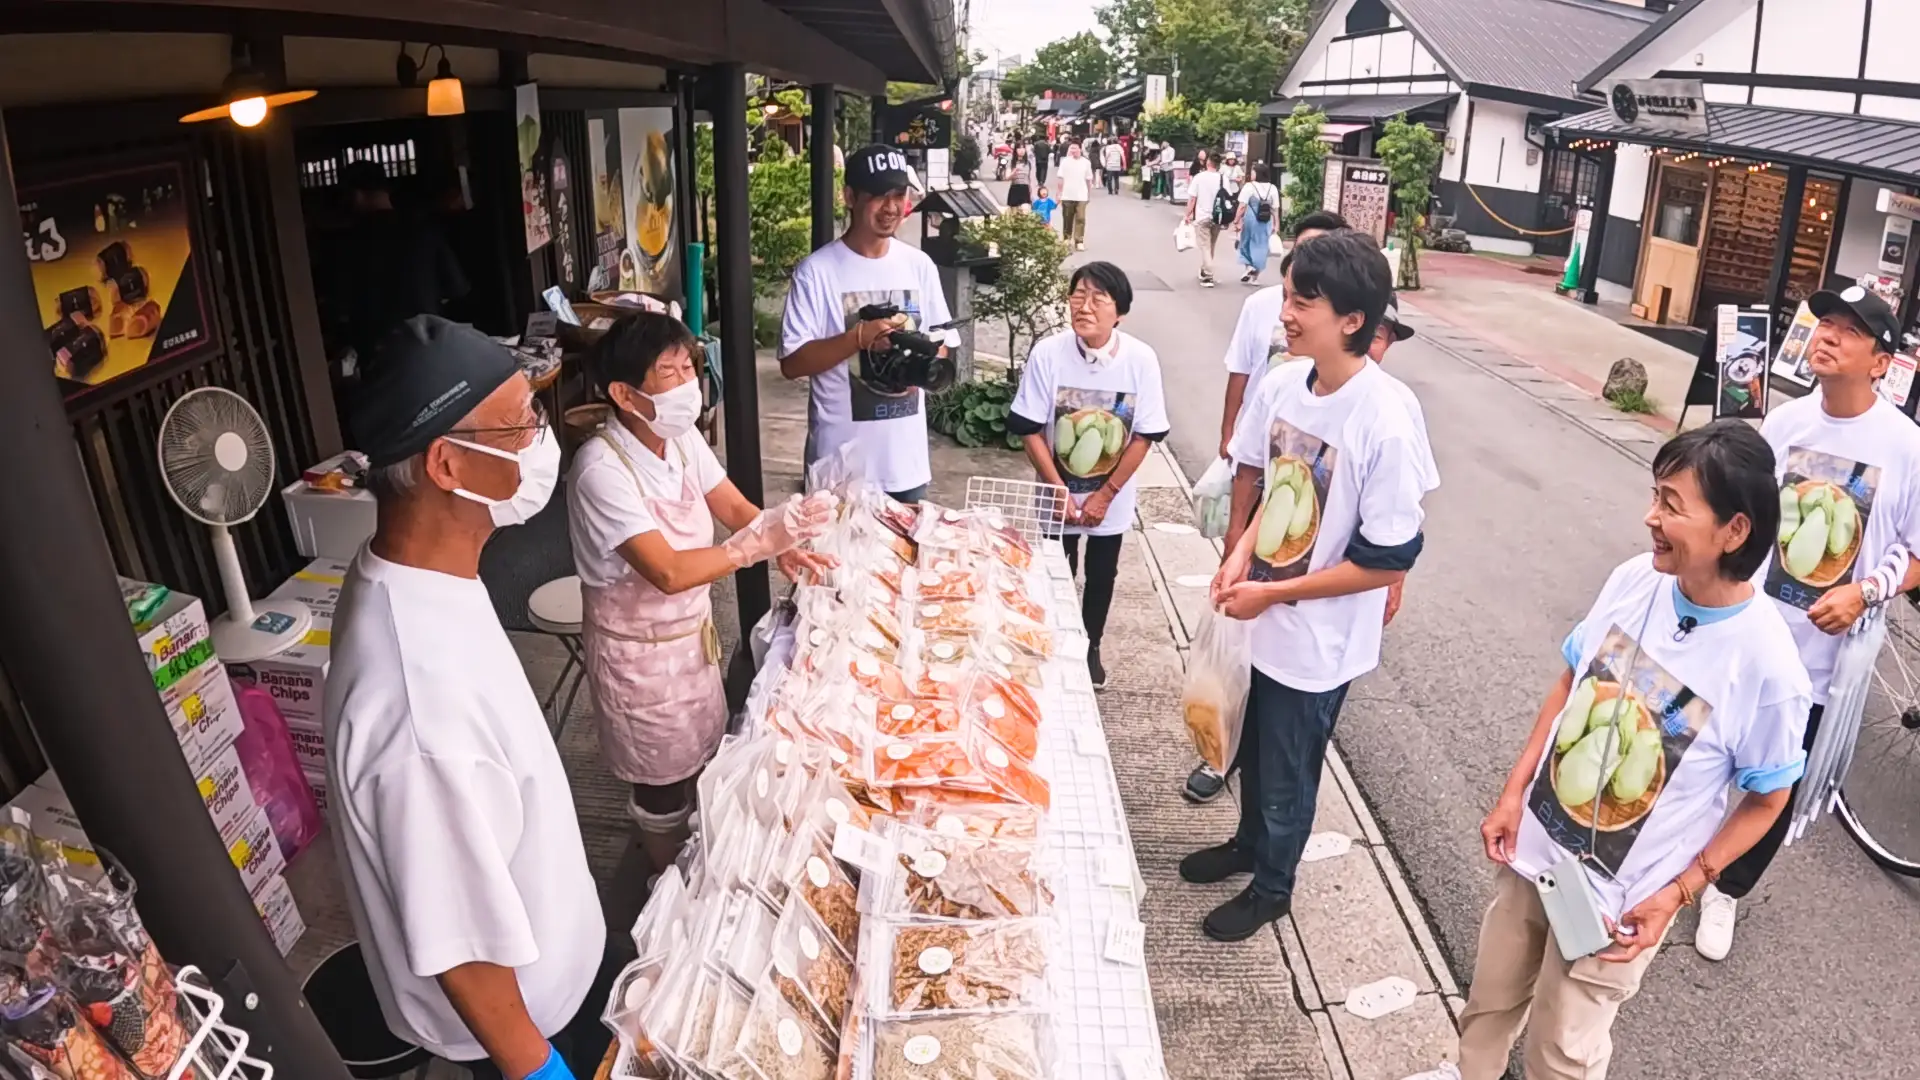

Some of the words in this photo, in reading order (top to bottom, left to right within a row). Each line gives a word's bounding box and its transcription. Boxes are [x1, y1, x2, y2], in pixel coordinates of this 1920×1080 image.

[260, 671, 313, 688] Banana
[270, 685, 310, 702] Chips
[213, 780, 240, 815] Chips
